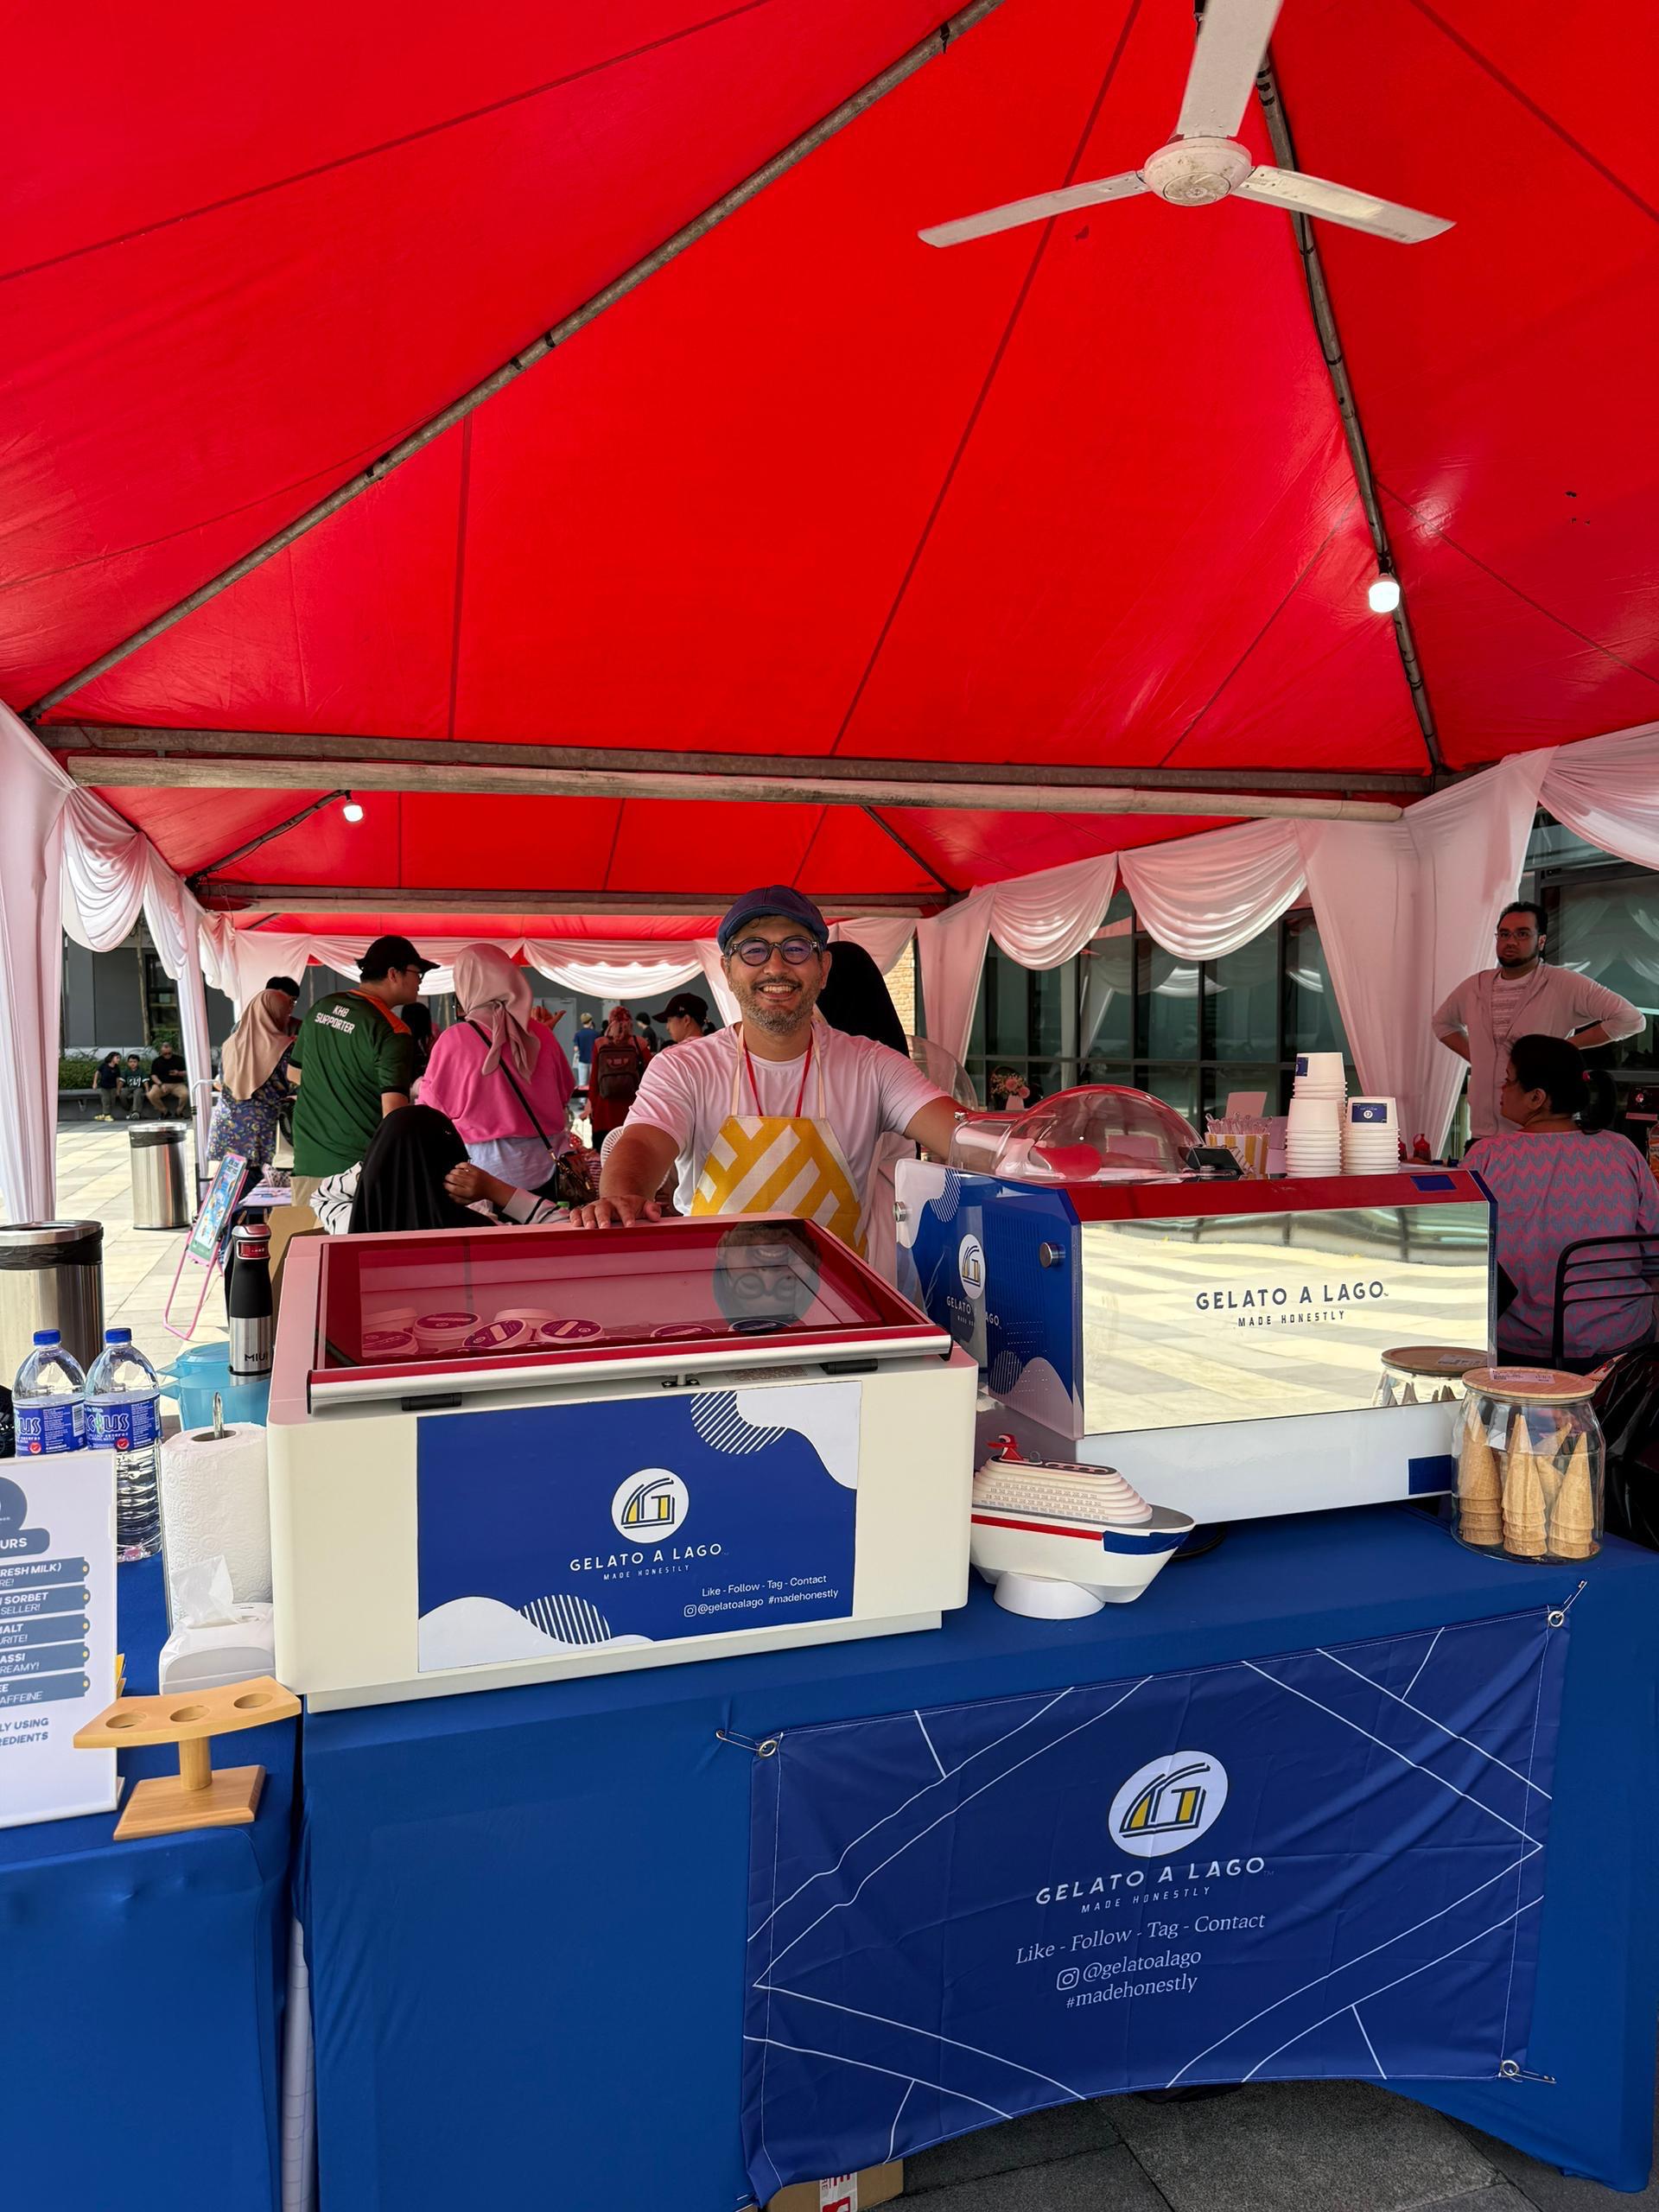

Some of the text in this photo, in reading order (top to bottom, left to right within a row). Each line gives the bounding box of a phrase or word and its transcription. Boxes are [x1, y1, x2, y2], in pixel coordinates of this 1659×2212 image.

[315, 1012, 355, 1034] SUPPORTER
[1196, 1281, 1383, 1311] GELATO A LAGO
[946, 1295, 971, 1314] GELATO
[985, 1312, 1000, 1326] AGO
[1238, 1310, 1344, 1327] MADE HONESTLY
[30, 1562, 61, 1574] MILK)
[569, 1543, 722, 1571] GELATO A LAGO
[603, 1565, 690, 1580] MADE HONESTLY
[4, 1592, 49, 1605] SORBET
[702, 1586, 721, 1597] Like
[728, 1582, 760, 1594] Follow
[766, 1580, 783, 1592] Tag
[790, 1575, 827, 1587] Contact
[1, 1604, 41, 1615] SELLER!
[697, 1588, 838, 1614] @gelatoalago #madehonestly
[14, 1718, 49, 1730] USING
[1036, 1871, 1144, 1905] GELATO
[1157, 1866, 1173, 1883] A
[1188, 1857, 1264, 1880] LAGO
[1081, 1886, 1211, 1914] MADE HONESTLY
[1015, 1943, 1056, 1964] Like
[1070, 1929, 1132, 1953] Follow
[1147, 1921, 1179, 1940] Tag
[1194, 1914, 1266, 1933] Contact
[1083, 1949, 1202, 1982] @gelatoalago
[1065, 1974, 1198, 2009] #madehonestly
